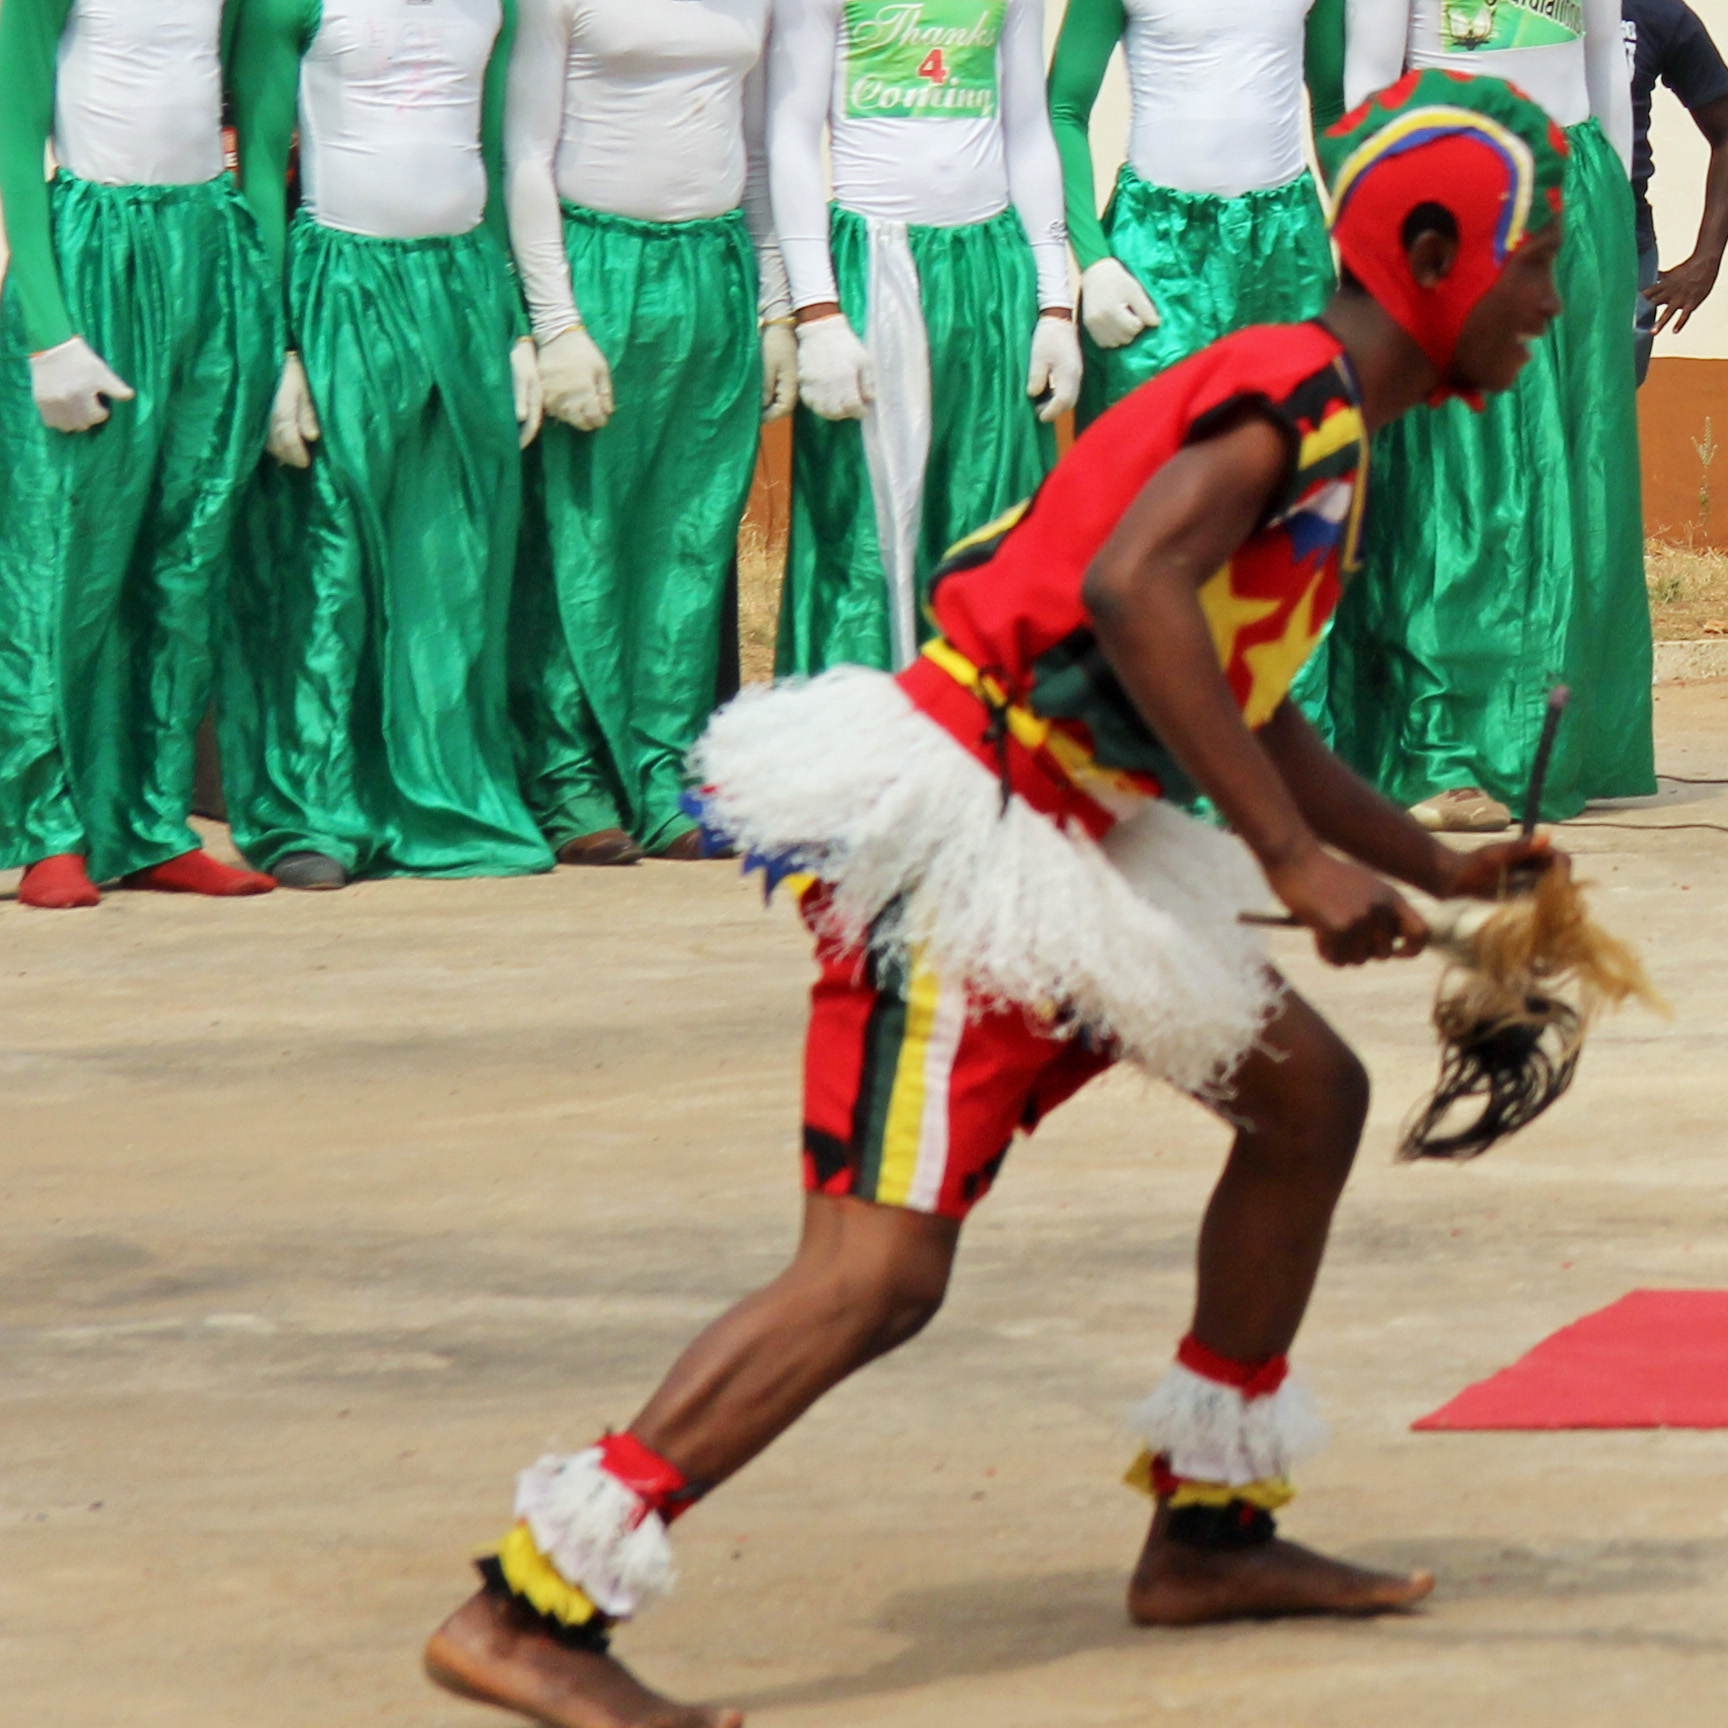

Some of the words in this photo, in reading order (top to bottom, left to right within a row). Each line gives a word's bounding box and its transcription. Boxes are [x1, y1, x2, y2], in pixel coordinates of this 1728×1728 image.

[842, 2, 997, 59] Thanks
[916, 46, 950, 88] 4
[851, 75, 994, 117] Coming
